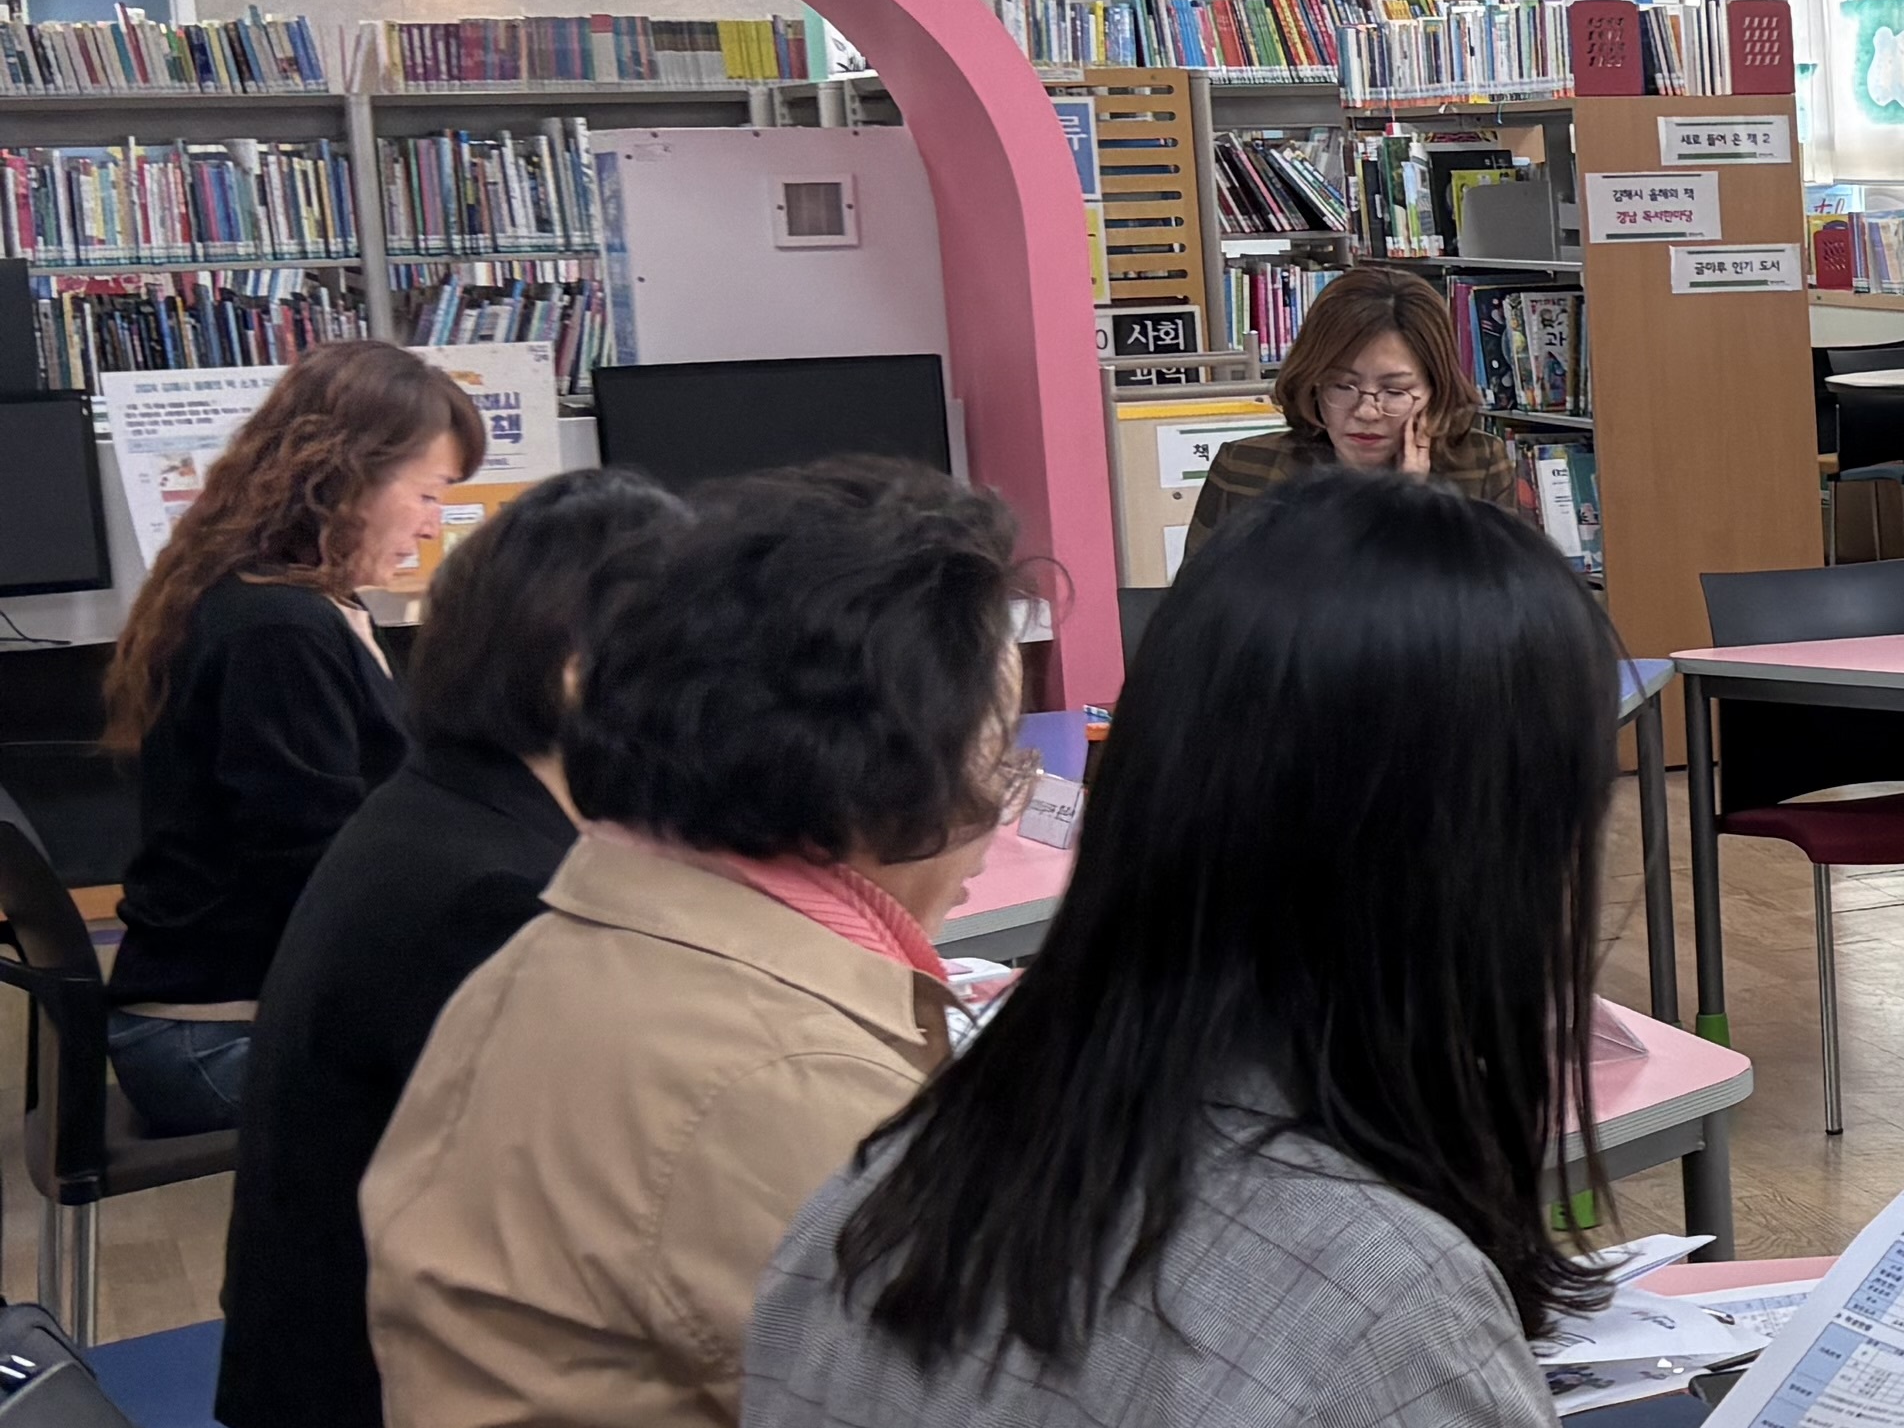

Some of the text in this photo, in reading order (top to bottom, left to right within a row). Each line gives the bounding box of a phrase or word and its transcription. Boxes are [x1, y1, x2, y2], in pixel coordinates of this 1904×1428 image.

[1762, 132, 1771, 144] 2
[1731, 261, 1754, 275] 인기
[1759, 259, 1780, 272] 도서
[1127, 318, 1186, 353] 사회
